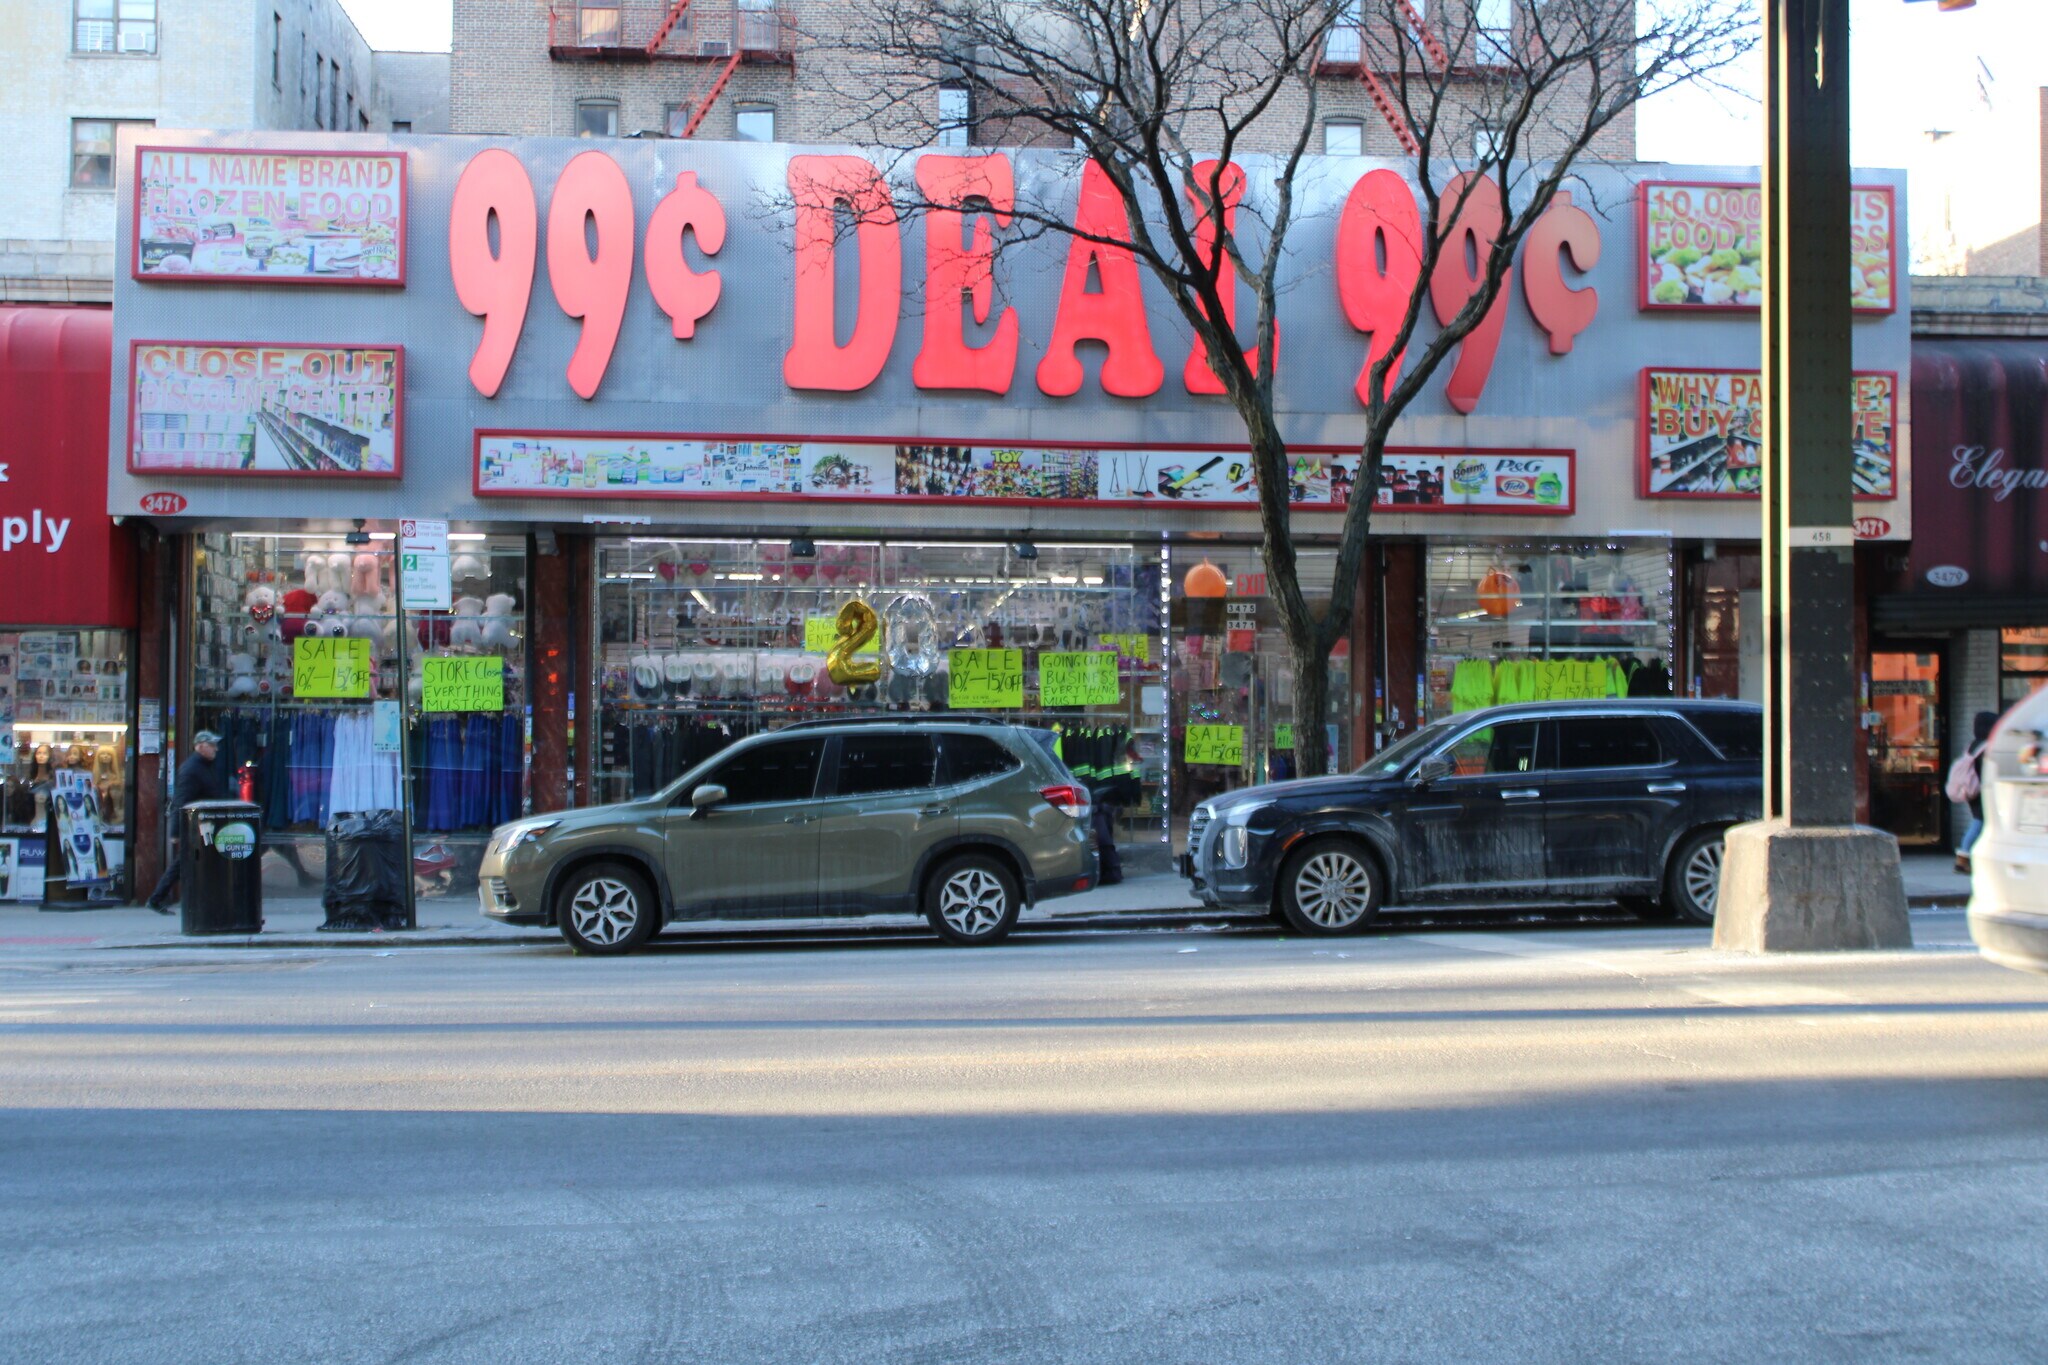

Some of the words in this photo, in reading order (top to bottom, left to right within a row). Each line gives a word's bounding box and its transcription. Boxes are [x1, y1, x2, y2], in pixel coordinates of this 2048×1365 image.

[149, 154, 198, 185] ALL
[208, 156, 288, 187] NAME
[298, 159, 394, 190] BRAND
[149, 187, 287, 219] FROZEN
[299, 191, 394, 222] FOOD
[1653, 220, 1736, 251] FOOD
[783, 153, 1280, 396] DEAL
[142, 348, 394, 385] CLOSE-OUT
[141, 381, 280, 413] DISCOUNT
[284, 384, 391, 414] CENTER
[1656, 376, 1720, 405] WHY
[1730, 378, 1762, 406] PA
[1656, 408, 1736, 439] BUY
[1494, 459, 1545, 473] P&G
[145, 496, 180, 512] 3471
[1812, 532, 1832, 542] 458
[1853, 518, 1885, 537] 3471
[406, 555, 414, 570] 2
[1228, 604, 1255, 613] 3475
[1228, 620, 1255, 630] 3471
[299, 639, 362, 661] SALE
[952, 650, 1016, 671] SALE
[1042, 655, 1081, 669] GOING
[350, 670, 371, 689] OFF
[424, 660, 470, 683] STORE
[1046, 670, 1116, 686] BUSINESS
[1543, 663, 1594, 685] SALE
[424, 685, 501, 699] EVERYTHING
[1004, 674, 1023, 692] OFF
[426, 700, 470, 712] MUST
[1043, 696, 1081, 707] MUST
[1189, 726, 1238, 741] SALE
